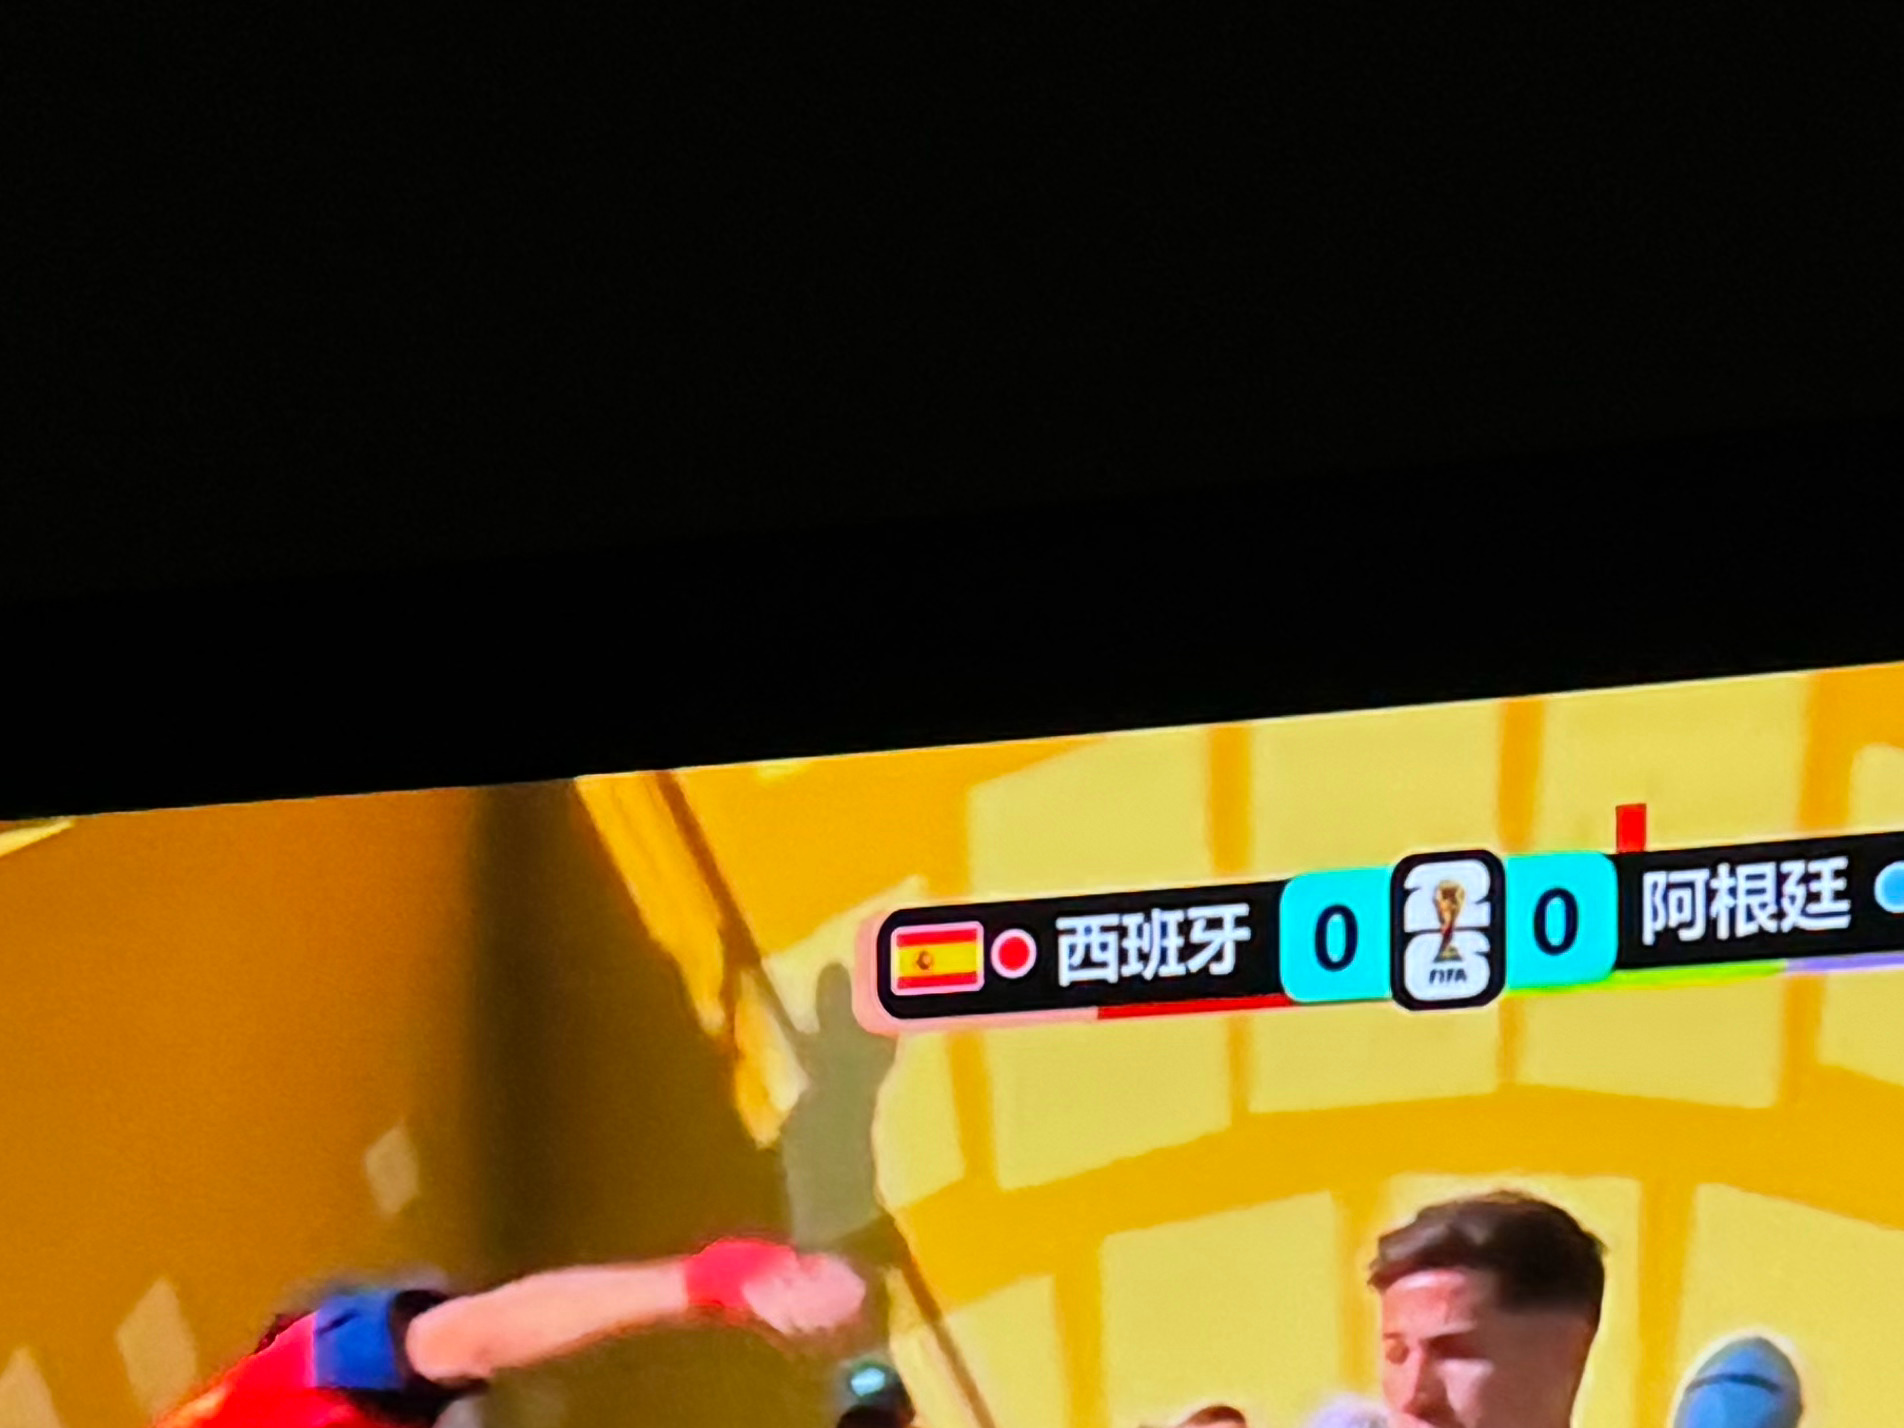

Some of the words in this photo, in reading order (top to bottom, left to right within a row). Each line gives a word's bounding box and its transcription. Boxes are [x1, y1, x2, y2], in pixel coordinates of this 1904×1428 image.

[1532, 887, 1580, 956] 0
[1642, 855, 1851, 946] 阿根廷
[1055, 902, 1251, 987] 西班牙
[1314, 904, 1359, 972] 0
[1428, 967, 1467, 984] FIFA
